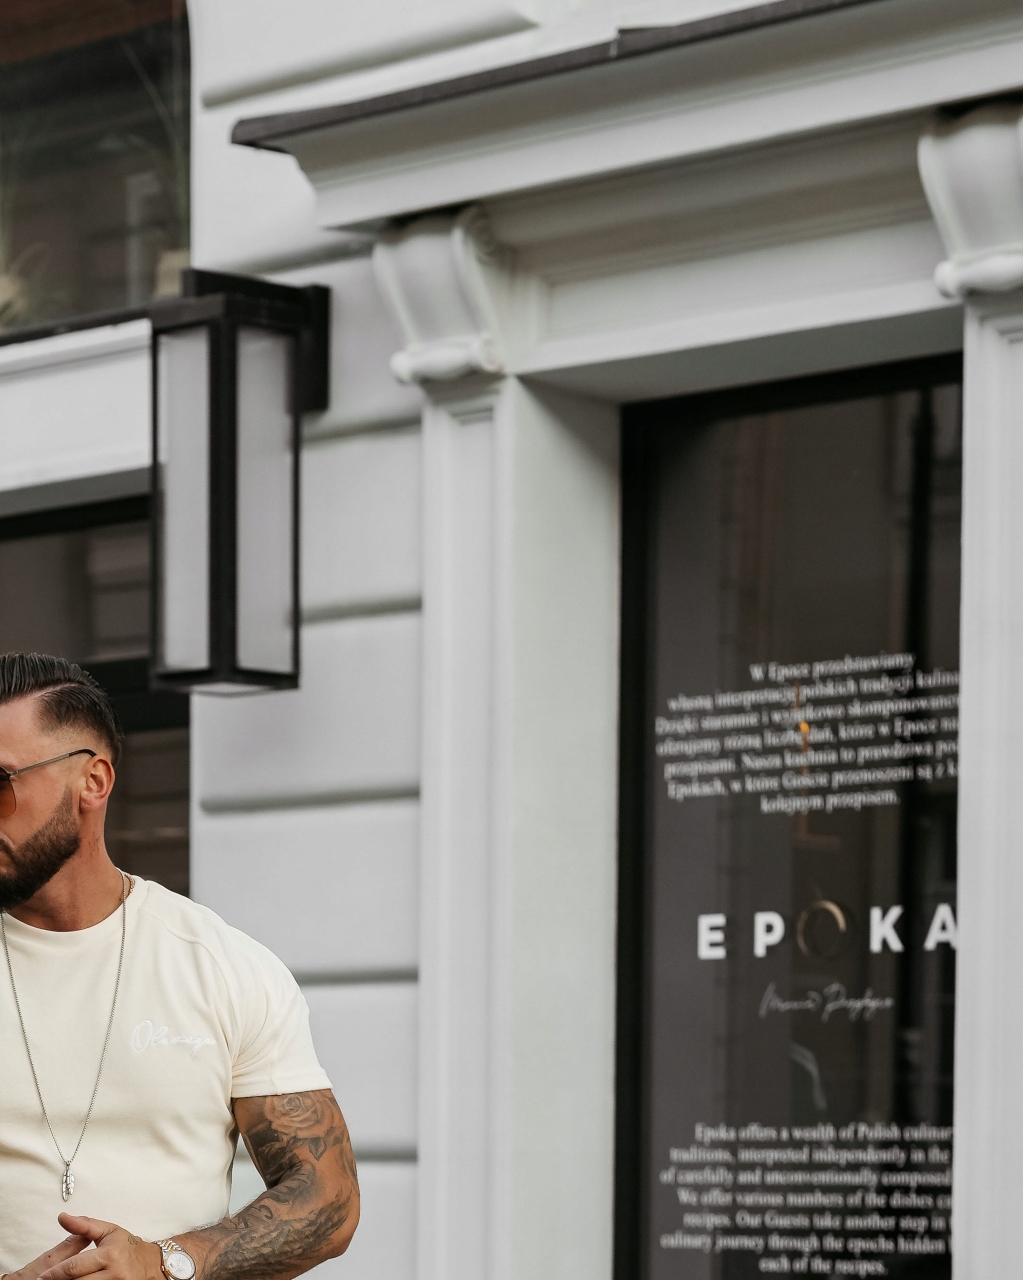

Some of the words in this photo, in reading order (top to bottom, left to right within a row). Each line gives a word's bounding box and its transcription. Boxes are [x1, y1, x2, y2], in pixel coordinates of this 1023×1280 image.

[749, 663, 767, 682] W
[695, 1122, 736, 1145] Epoka
[738, 1122, 777, 1141] offers
[779, 1126, 789, 1141] a
[791, 1122, 836, 1141] wealth
[838, 1122, 856, 1141] of
[857, 1122, 901, 1141] Polish
[737, 1144, 810, 1167] interpreted
[811, 1144, 908, 1167] independently
[909, 1144, 926, 1164] in
[927, 1144, 950, 1164] the
[659, 1165, 676, 1185] of
[676, 1165, 734, 1189] carefully
[736, 1166, 763, 1185] and
[677, 1187, 699, 1206] We
[700, 1187, 732, 1206] offer
[734, 1188, 785, 1207] various
[786, 1188, 844, 1208] numbers
[846, 1188, 863, 1208] of
[864, 1189, 887, 1208] the
[889, 1189, 934, 1209] dishes
[735, 1209, 762, 1229] Our
[764, 1209, 811, 1229] Guests
[812, 1210, 842, 1230] take
[844, 1211, 896, 1231] another
[898, 1213, 929, 1235] step
[930, 1211, 947, 1231] in
[660, 1230, 712, 1253] culinary
[713, 1230, 765, 1254] journey
[767, 1231, 820, 1256] through
[822, 1232, 845, 1252] the
[846, 1234, 895, 1258] epochs
[897, 1234, 946, 1254] hidden
[758, 1253, 791, 1273] each
[792, 1253, 809, 1273] of
[810, 1254, 833, 1273] the
